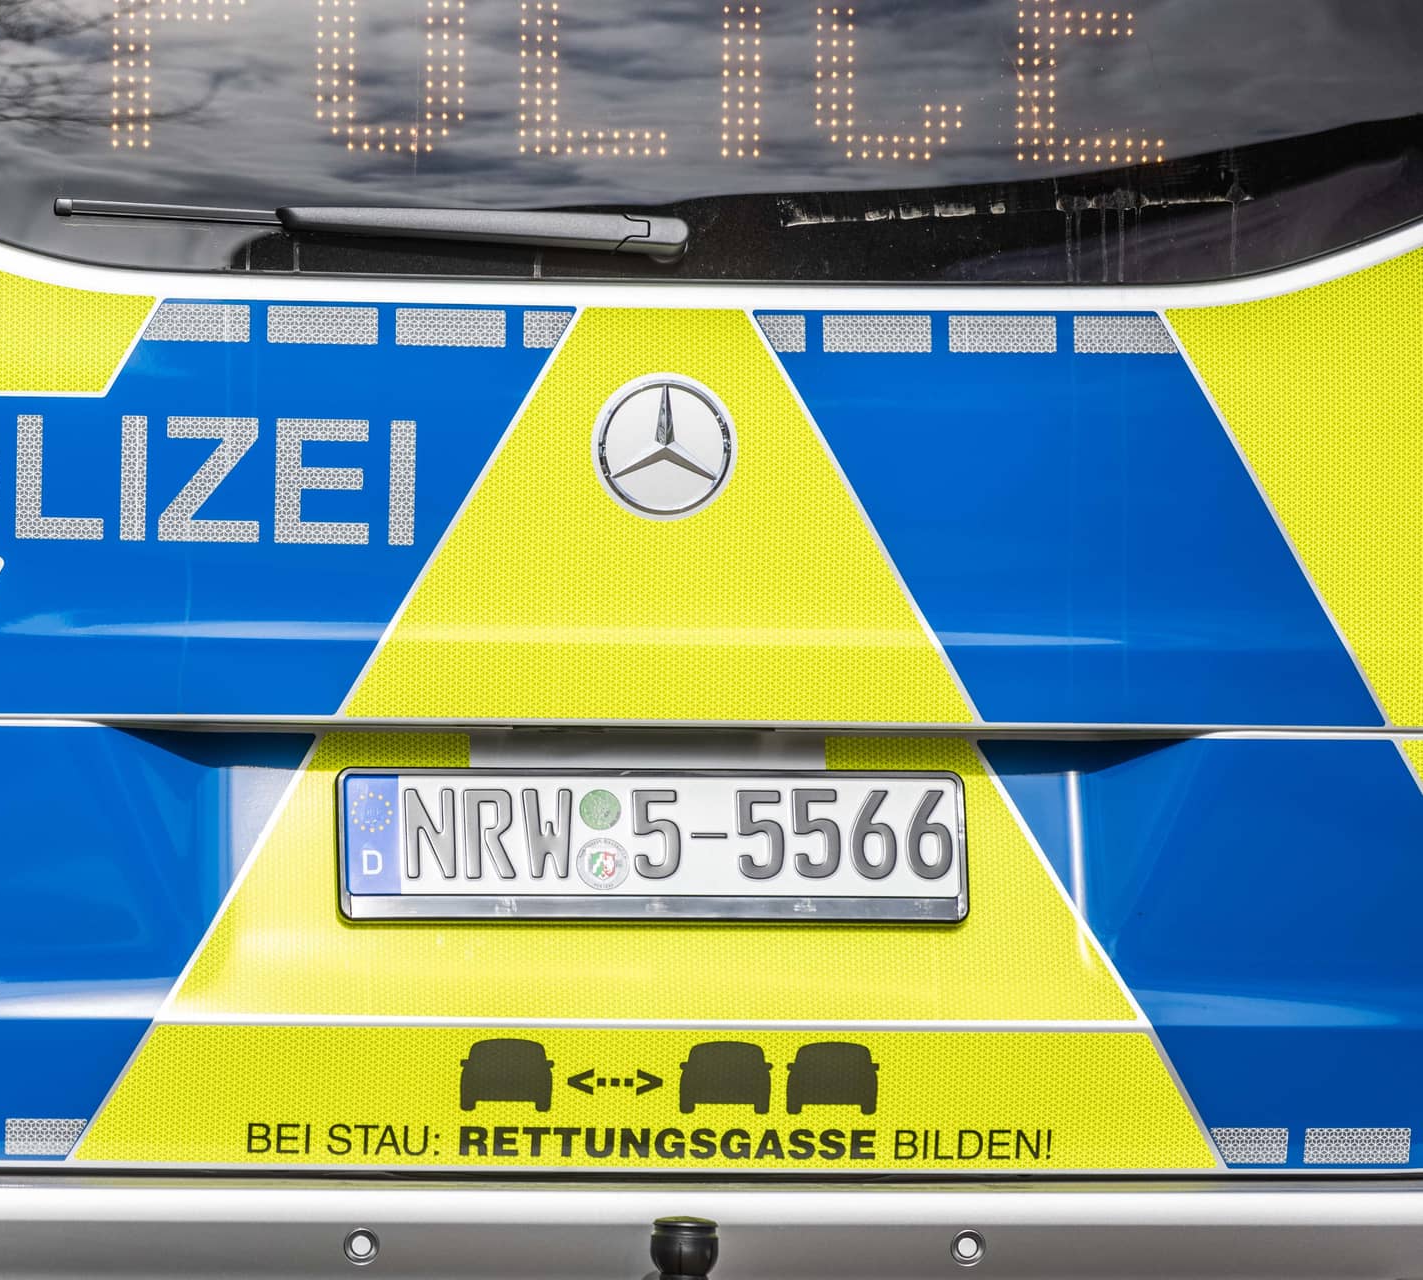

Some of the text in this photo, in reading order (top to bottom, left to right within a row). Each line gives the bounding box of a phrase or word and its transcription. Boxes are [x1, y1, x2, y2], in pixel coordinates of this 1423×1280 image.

[404, 788, 954, 881] NRW 5-5566
[362, 849, 383, 876] D
[248, 1123, 1053, 1160] BEI STAU: RETTUNGSGASSE BILDEN!
